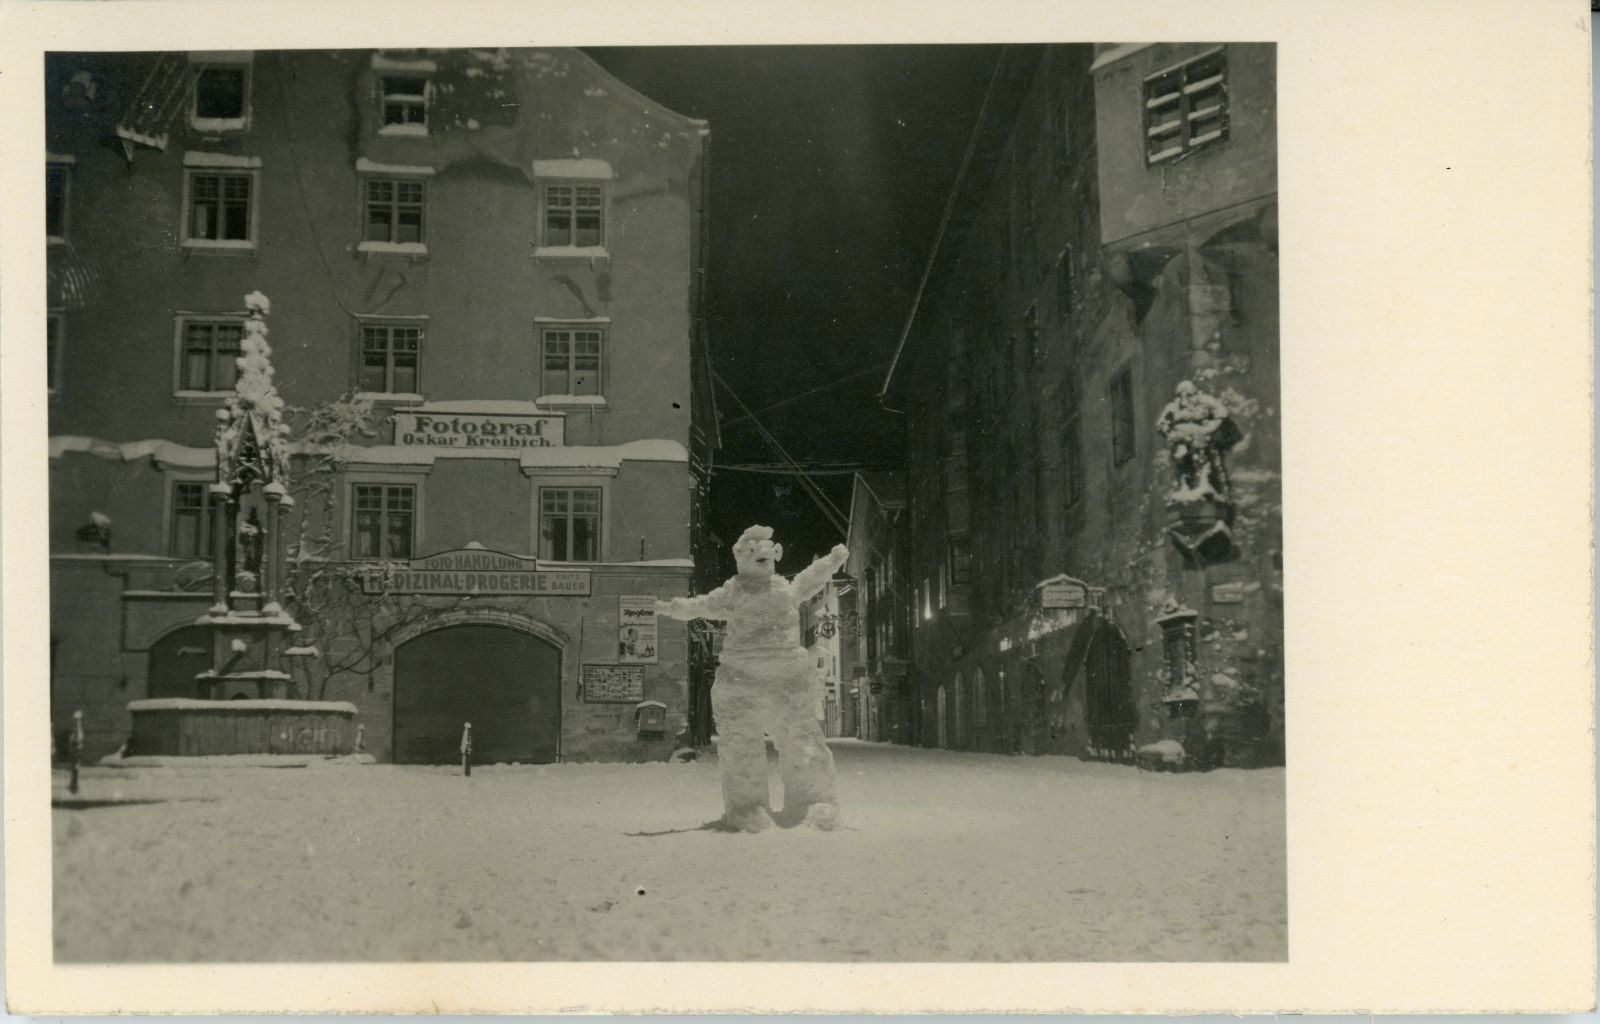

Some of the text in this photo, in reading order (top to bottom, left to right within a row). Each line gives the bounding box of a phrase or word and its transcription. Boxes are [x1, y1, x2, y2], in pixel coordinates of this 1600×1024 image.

[414, 416, 548, 437] Fotograf
[403, 432, 556, 448] Oskar Kreibich.
[552, 582, 586, 591] BAUER
